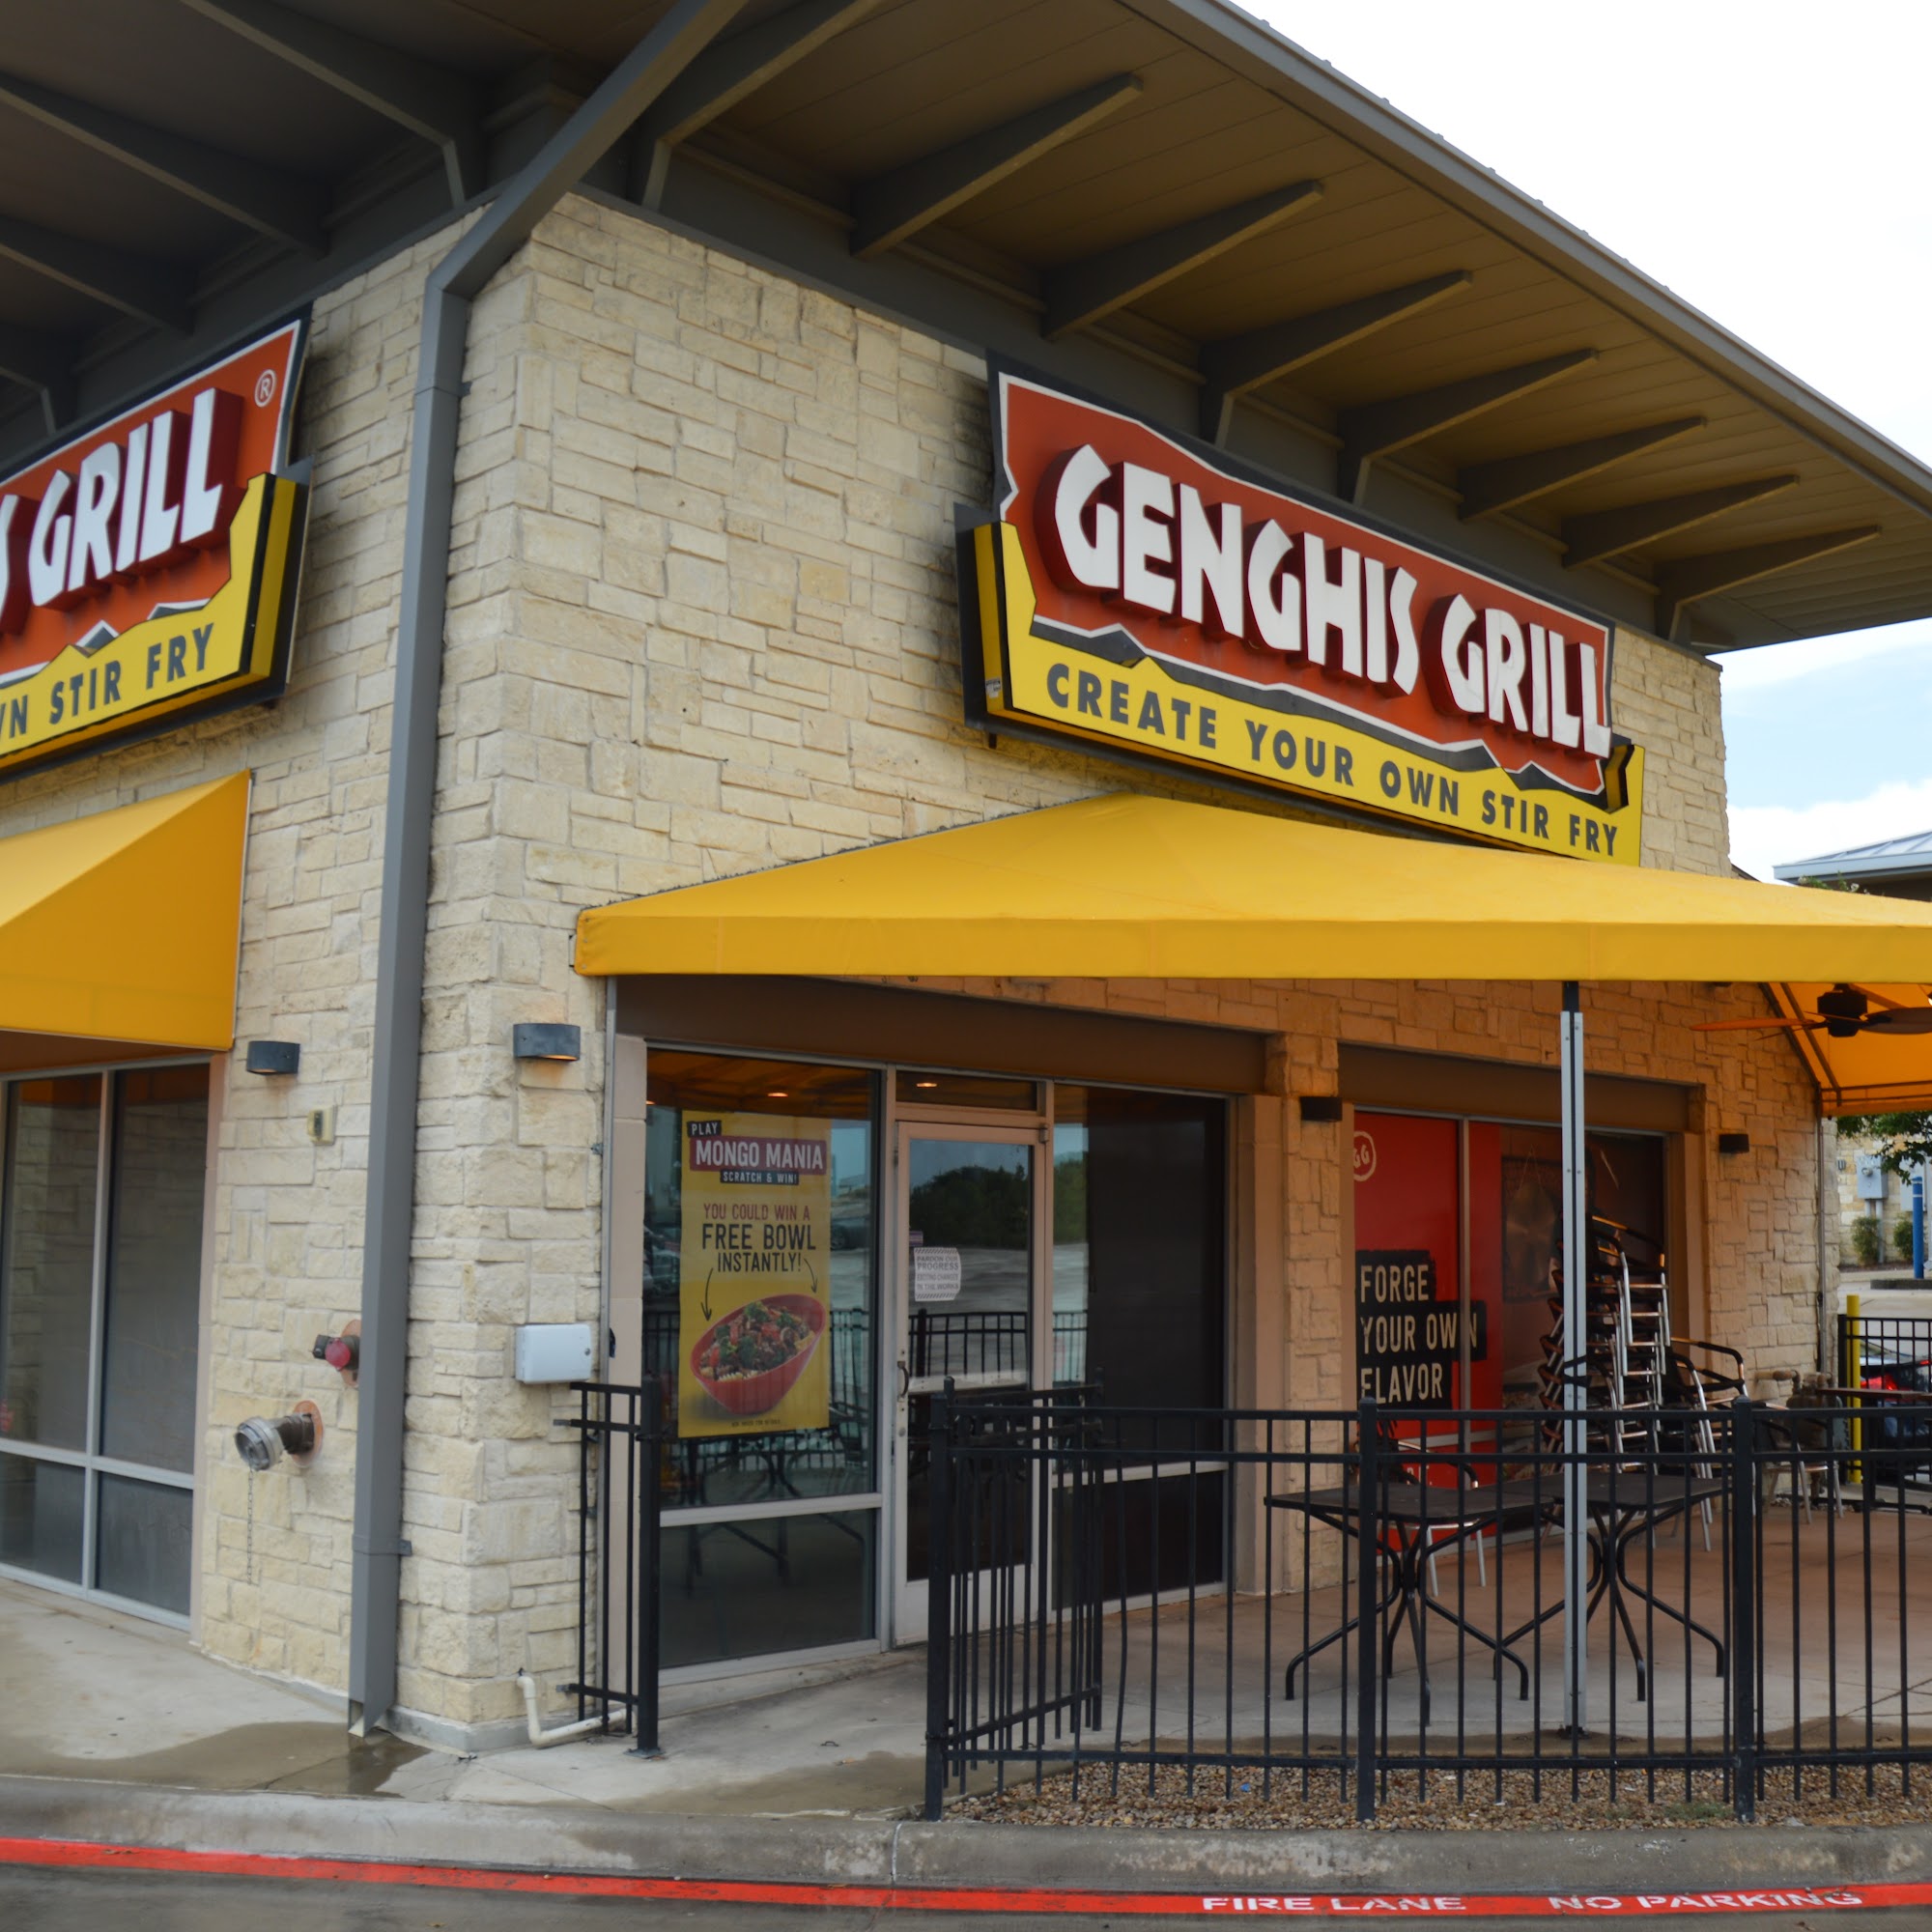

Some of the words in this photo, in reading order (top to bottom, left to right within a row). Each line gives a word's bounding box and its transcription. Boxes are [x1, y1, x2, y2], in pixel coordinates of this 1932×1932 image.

[28, 387, 223, 607] GRILL
[1054, 443, 1420, 696] GENGHIS
[1440, 593, 1612, 759] GRILL
[49, 660, 122, 725] STIR
[146, 622, 214, 690] FRY
[1046, 662, 1218, 751] CREATE
[1244, 720, 1354, 787] YOUR
[1379, 760, 1460, 816] OWN
[1481, 789, 1549, 839] STIR
[1569, 816, 1618, 858] FRY
[691, 1122, 719, 1136] PLAY
[696, 1140, 760, 1168] MONGO
[766, 1142, 823, 1170] MANIA
[723, 1171, 762, 1182] SCRATCH
[766, 1173, 773, 1183] &
[703, 1204, 727, 1220] YOU
[731, 1205, 769, 1221] COULD
[774, 1206, 797, 1221] WIN
[803, 1206, 810, 1221] A
[702, 1223, 753, 1250] FREE
[763, 1224, 816, 1250] BOWL
[718, 1252, 802, 1272] INSTANTLY!
[1360, 1264, 1430, 1303] FORGE
[1360, 1314, 1416, 1354] YOUR
[1426, 1312, 1478, 1350] OWN
[1360, 1362, 1443, 1406] FLAVOR
[1203, 1897, 1315, 1911] FIRE
[1330, 1896, 1466, 1911] LANE
[1548, 1895, 1623, 1910] NO
[1636, 1892, 1863, 1909] PARKING
